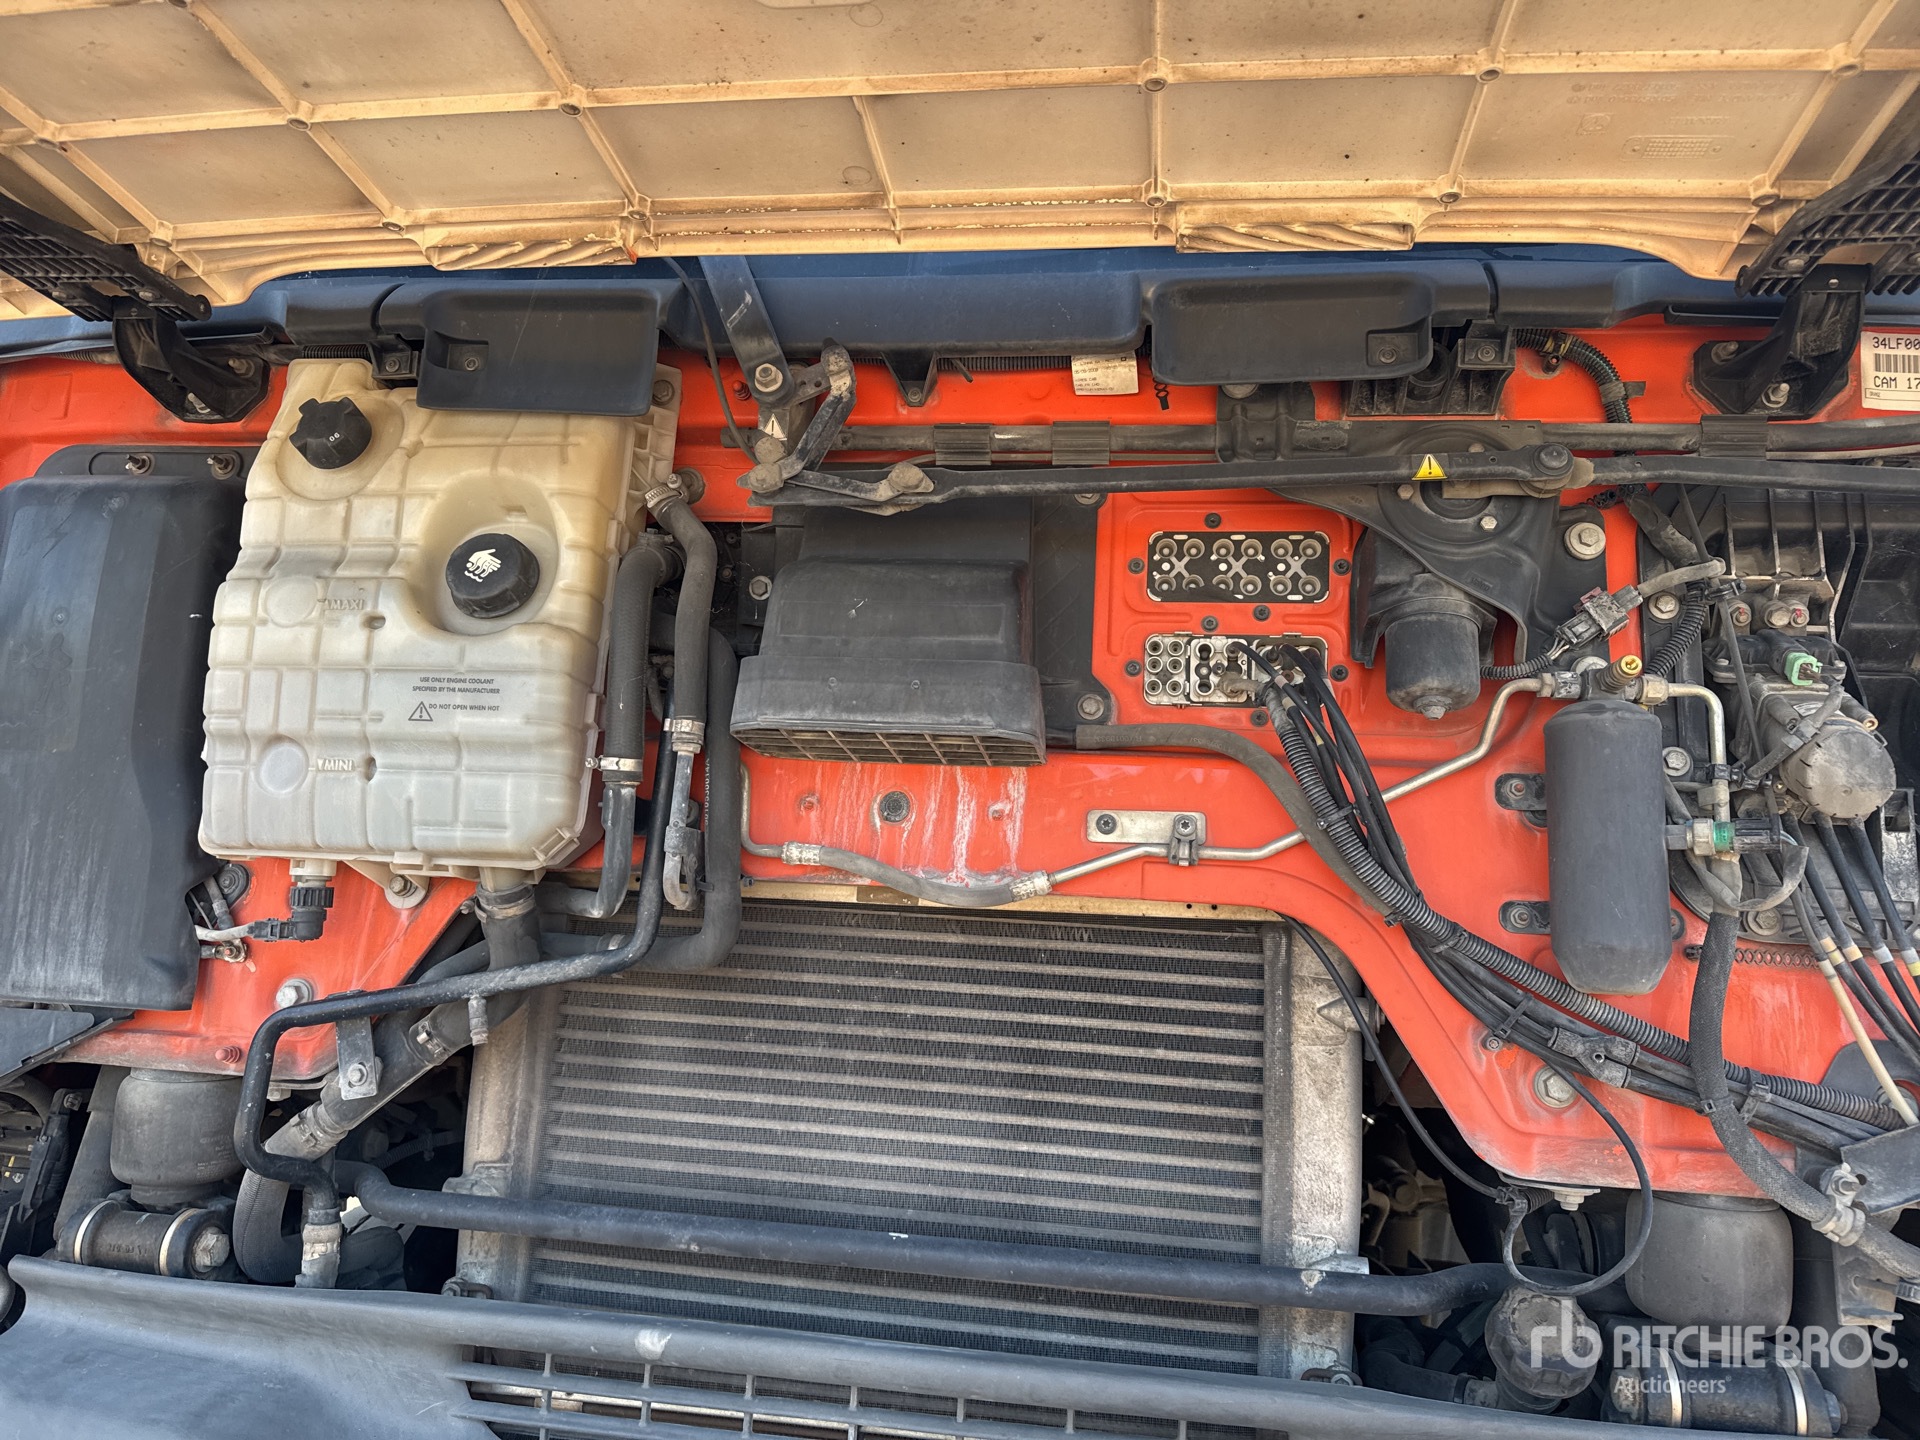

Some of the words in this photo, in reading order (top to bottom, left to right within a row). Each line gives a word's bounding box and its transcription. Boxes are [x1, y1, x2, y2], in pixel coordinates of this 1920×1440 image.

[1872, 336, 1920, 350] 34LF00
[1873, 375, 1898, 389] CAM
[330, 598, 365, 611] MAXI
[323, 758, 354, 771] MINI
